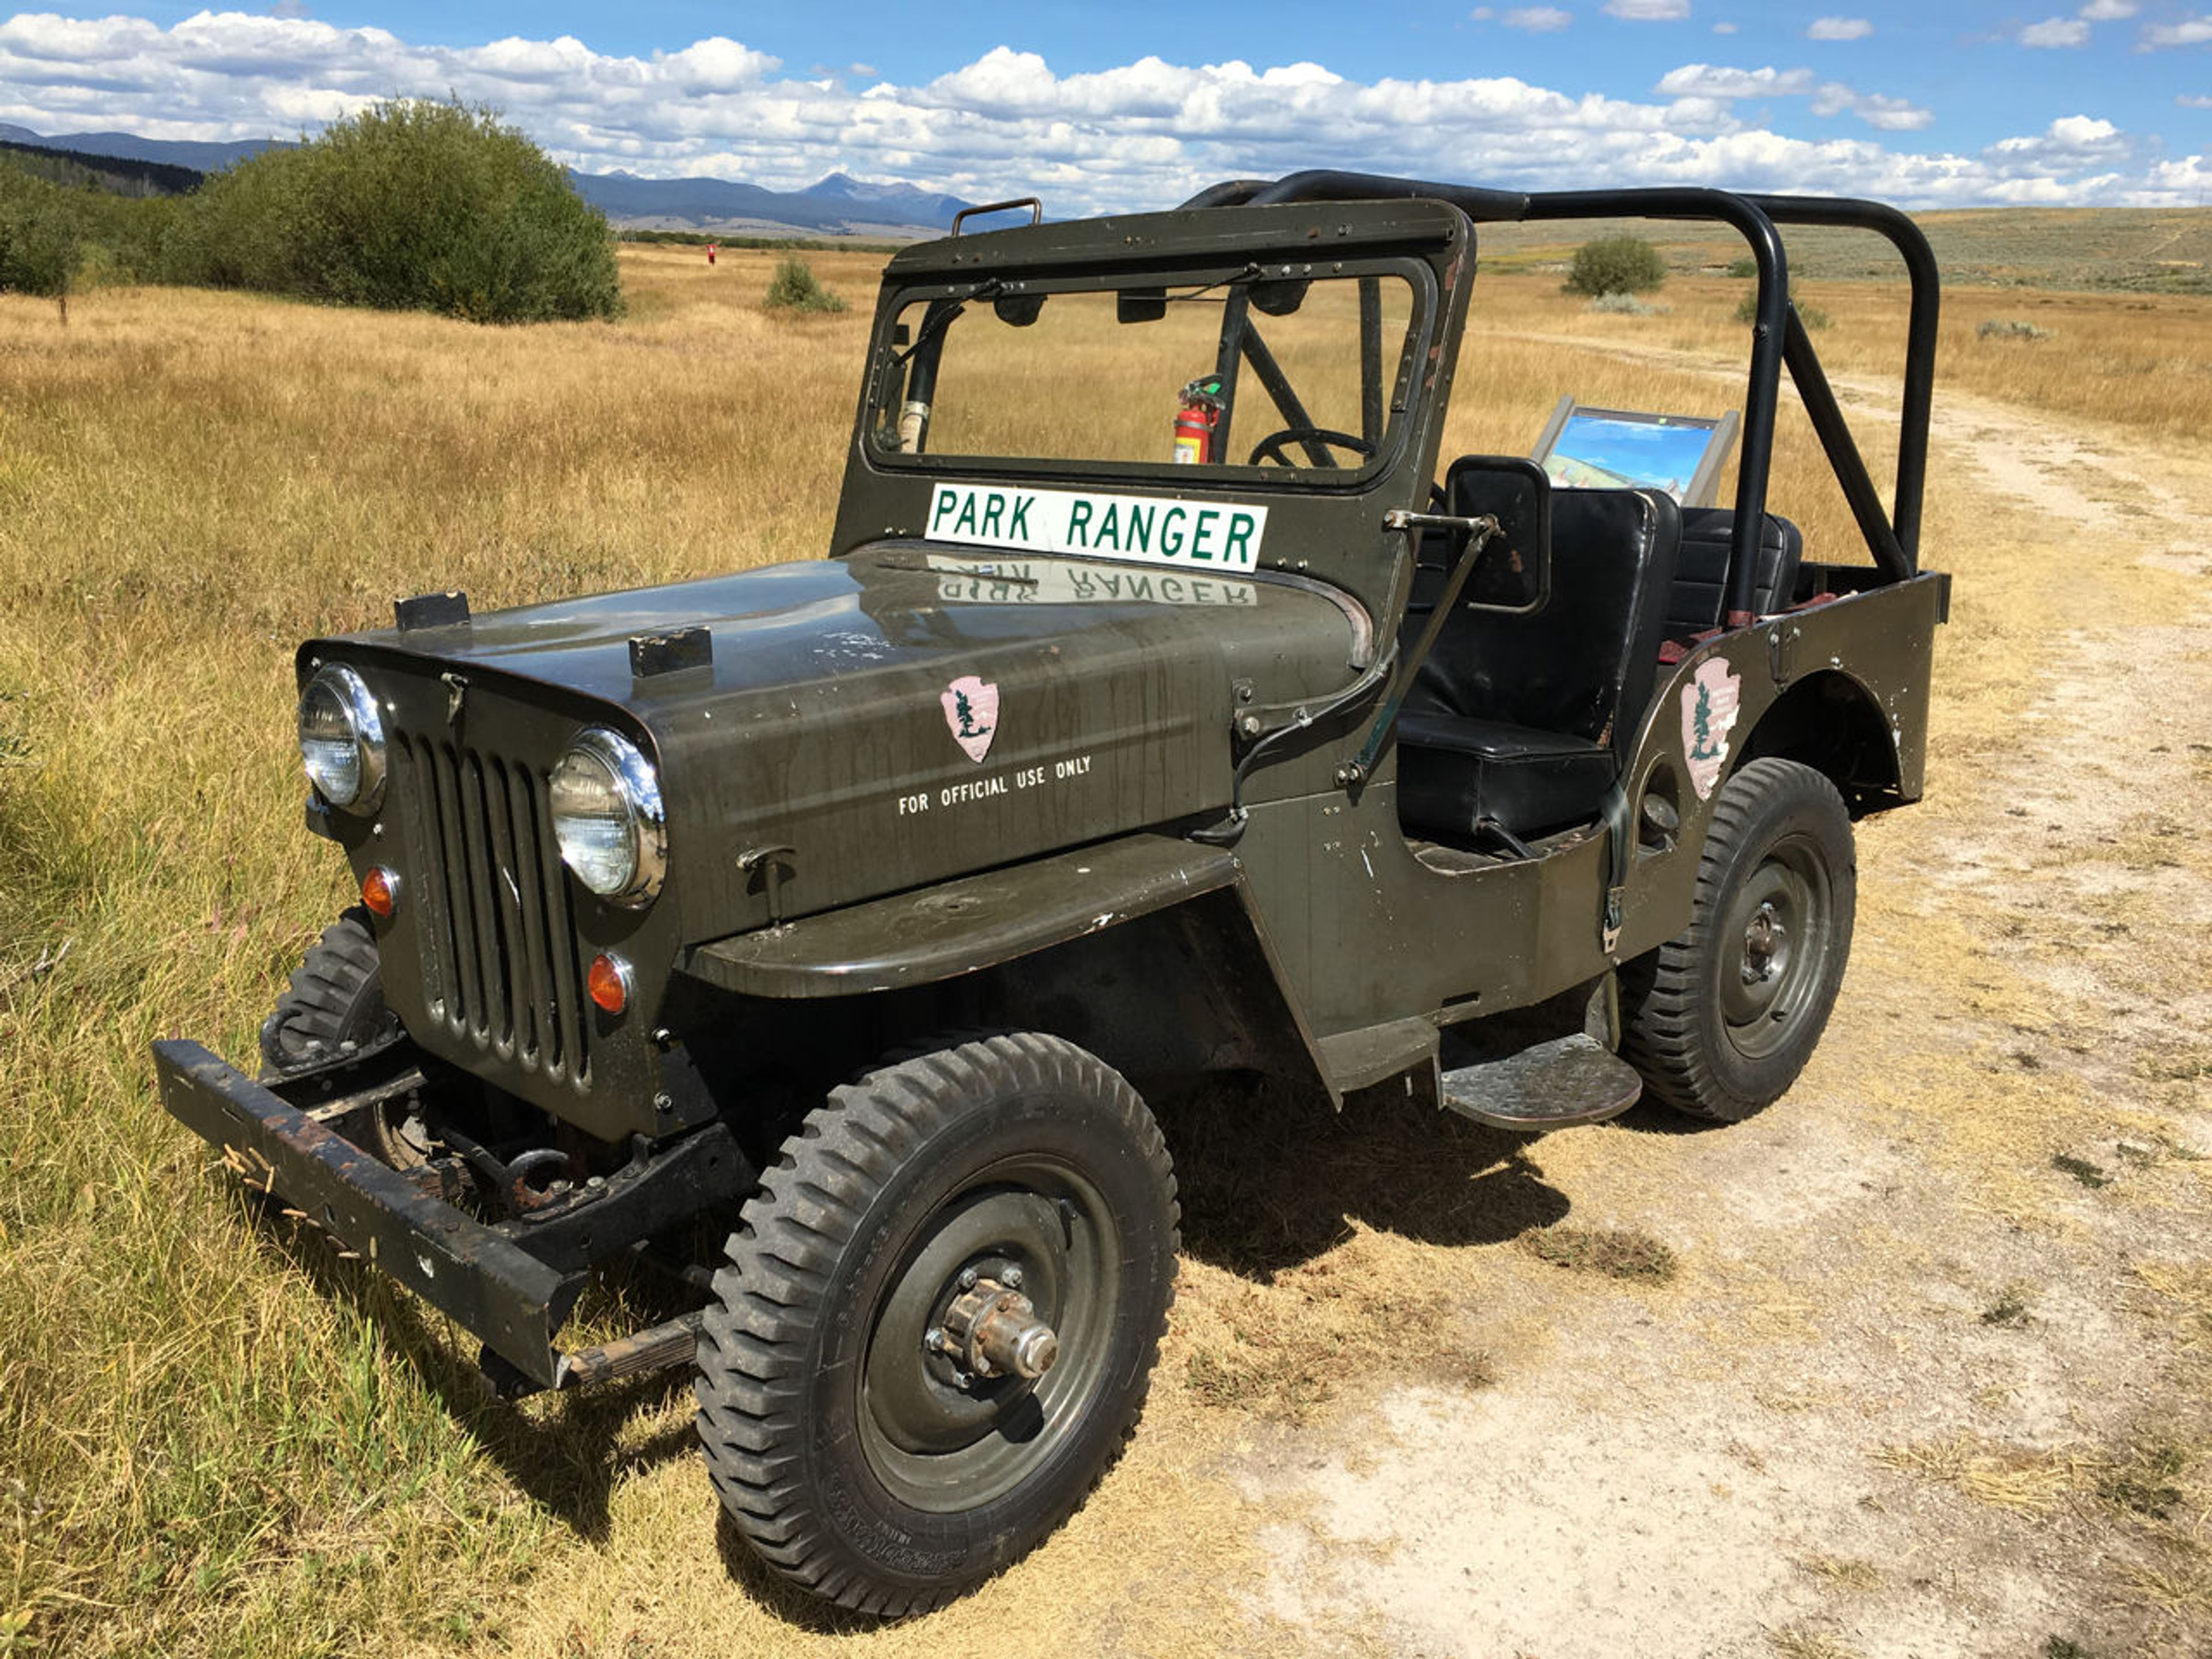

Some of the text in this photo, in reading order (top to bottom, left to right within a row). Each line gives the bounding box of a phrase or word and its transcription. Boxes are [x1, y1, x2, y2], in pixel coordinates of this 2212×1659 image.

[933, 490, 1255, 564] PARK RANGER
[899, 755, 1092, 815] FOR OFFICIAL USE ONLY
